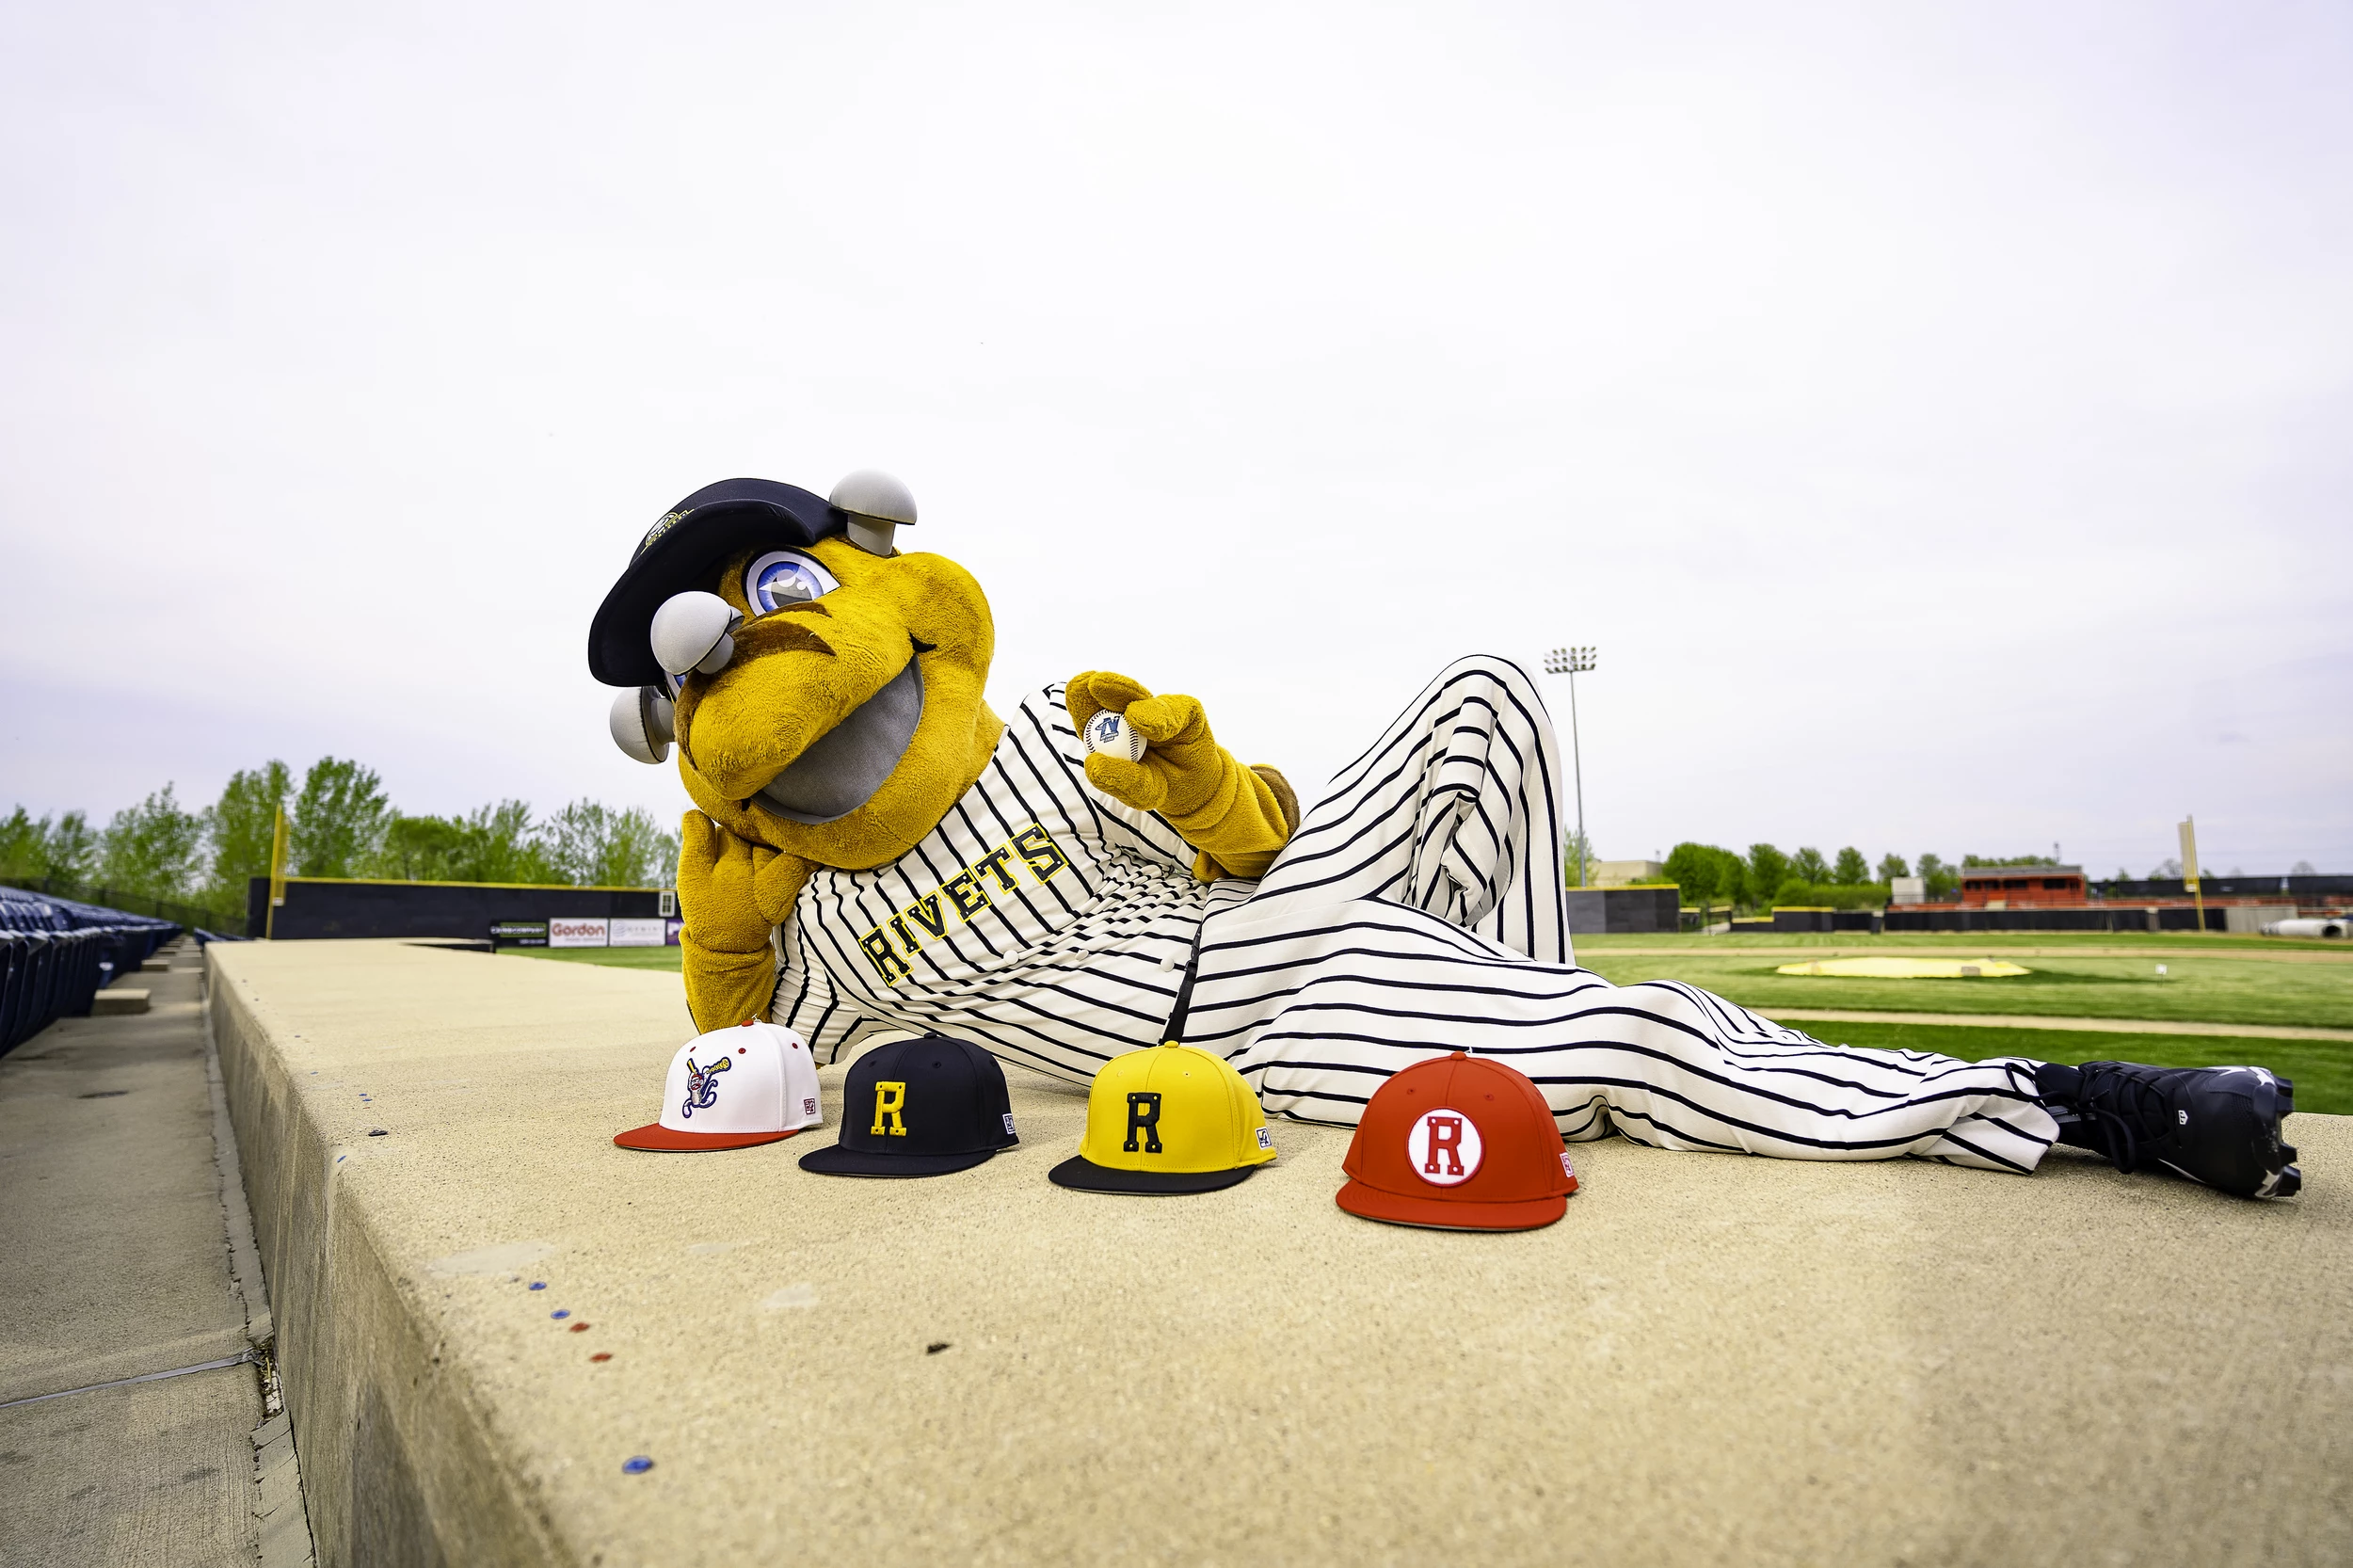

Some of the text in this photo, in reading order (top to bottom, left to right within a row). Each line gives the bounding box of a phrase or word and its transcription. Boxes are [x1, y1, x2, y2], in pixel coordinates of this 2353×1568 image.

[552, 922, 605, 937] Gordon
[858, 823, 1069, 987] RIVETS
[871, 1080, 907, 1137] R
[1123, 1092, 1163, 1154] R
[1424, 1116, 1465, 1176] R
